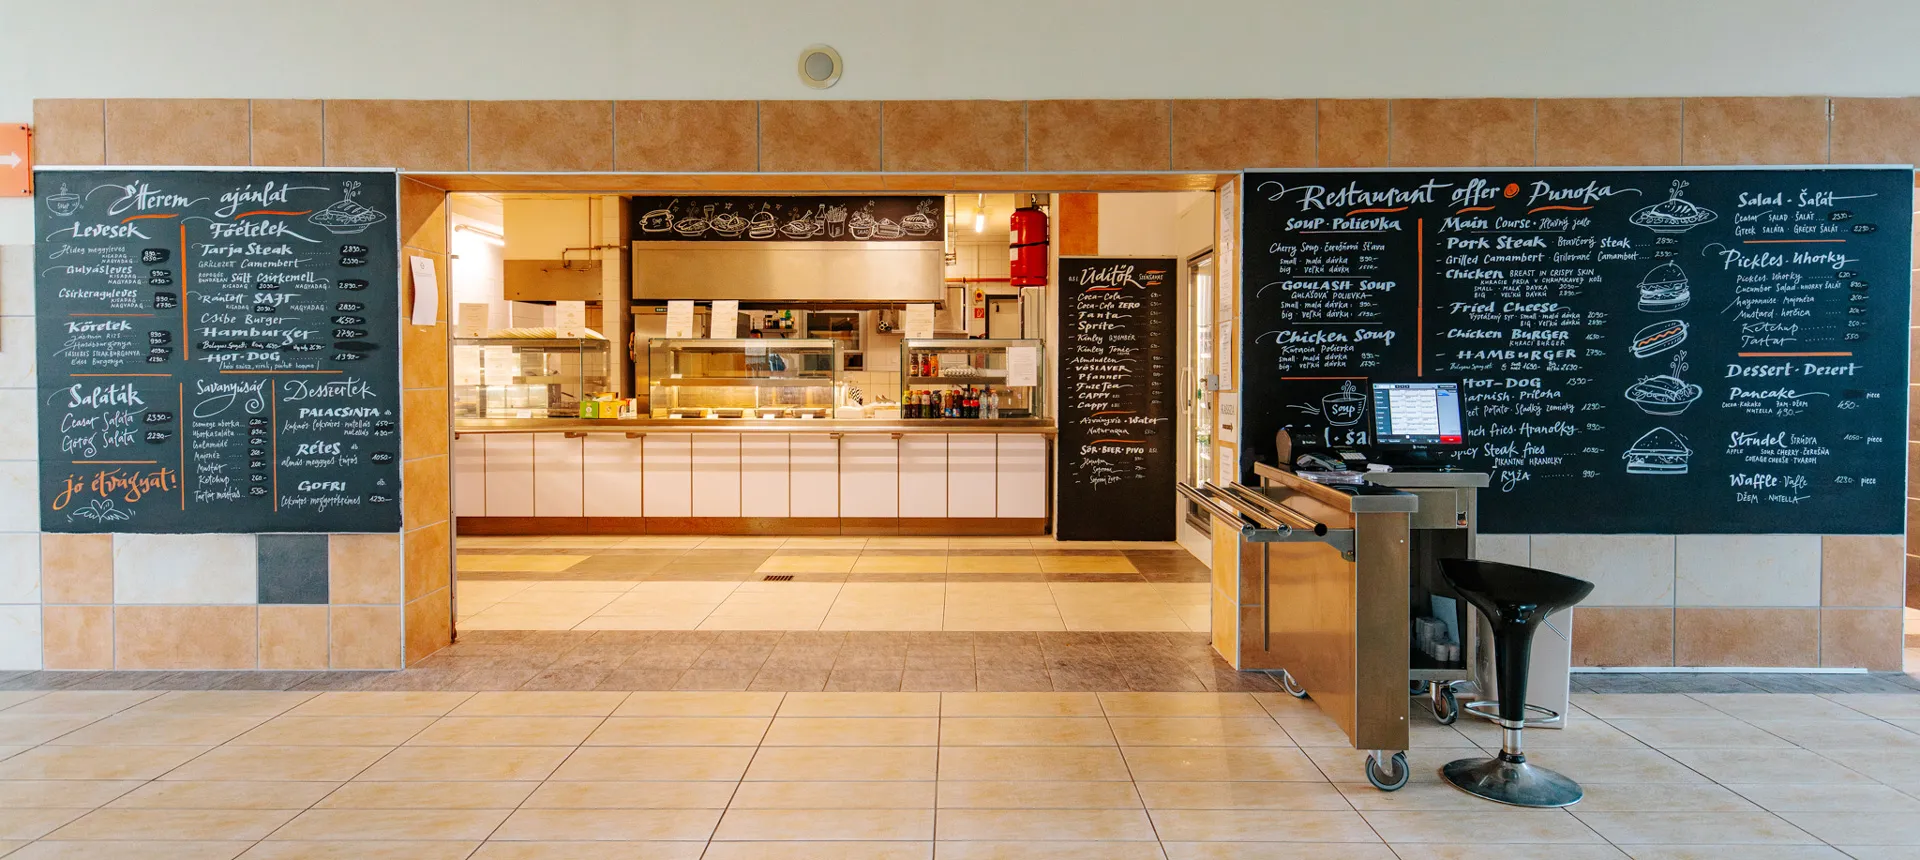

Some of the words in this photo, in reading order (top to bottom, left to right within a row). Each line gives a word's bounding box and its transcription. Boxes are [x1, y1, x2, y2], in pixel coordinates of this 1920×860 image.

[215, 181, 298, 218] ajánlat
[1296, 178, 1448, 212] Restaurant
[1448, 178, 1500, 207] offer
[1527, 180, 1624, 206] Punoka
[1738, 192, 1782, 208] Salad
[1798, 188, 1850, 207] Šalát
[1332, 216, 1402, 231] Polievka
[1769, 213, 1788, 221] SALAD
[66, 221, 151, 240] Levesek
[1438, 217, 1488, 233] Main
[1495, 217, 1530, 230] Course
[1447, 236, 1490, 249] Pork
[1496, 236, 1547, 249] Steak
[1600, 236, 1631, 249] Steak
[200, 243, 243, 257] Tarja
[245, 243, 293, 256] Steak
[1270, 242, 1297, 257] Cherry
[1445, 254, 1478, 265] Grilled
[1719, 248, 1782, 270] Pickles
[66, 264, 133, 276] Gulyásleves
[1445, 268, 1504, 279] Chicken
[1077, 292, 1128, 301] Coca-Cola
[1076, 302, 1115, 310] Coca-Cola
[1450, 302, 1495, 314] Fried
[1503, 301, 1562, 312] Cheese
[200, 313, 236, 325] Csibe
[245, 314, 292, 326] Burger
[1078, 311, 1126, 320] Fanta
[1282, 311, 1293, 320] big
[1078, 321, 1120, 333] Sprite
[1447, 328, 1502, 339] Chicken
[1742, 322, 1799, 336] Ketchup
[200, 327, 318, 346] Hamburger
[1077, 334, 1103, 344] Kinley
[1276, 330, 1348, 344] Chicken
[1353, 329, 1395, 346] Soup
[1077, 345, 1104, 355] Kinley
[1456, 349, 1576, 360] HAMBURGER
[1724, 362, 1794, 378] Dessert
[1804, 362, 1859, 376] Dezert
[67, 383, 145, 409] Saláták
[193, 379, 267, 418] Savanyúság
[284, 377, 376, 402] Desszertek
[1078, 392, 1110, 400] CAPPY
[1465, 391, 1510, 402] arnish
[1520, 389, 1561, 400] Príloha
[1730, 387, 1808, 400] Pancake
[299, 407, 379, 418] PALACSINTA
[1077, 402, 1108, 410] Cappy
[1332, 403, 1356, 417] Soup
[102, 408, 142, 432] Saláta
[1128, 416, 1162, 424] Water
[1468, 425, 1485, 437] nch
[103, 429, 138, 448] Saláta
[1728, 431, 1788, 448] Strudel
[1484, 441, 1519, 458] Steak
[1522, 442, 1545, 458] fries
[298, 481, 345, 491] GOFRI
[1729, 473, 1777, 489] Waffle
